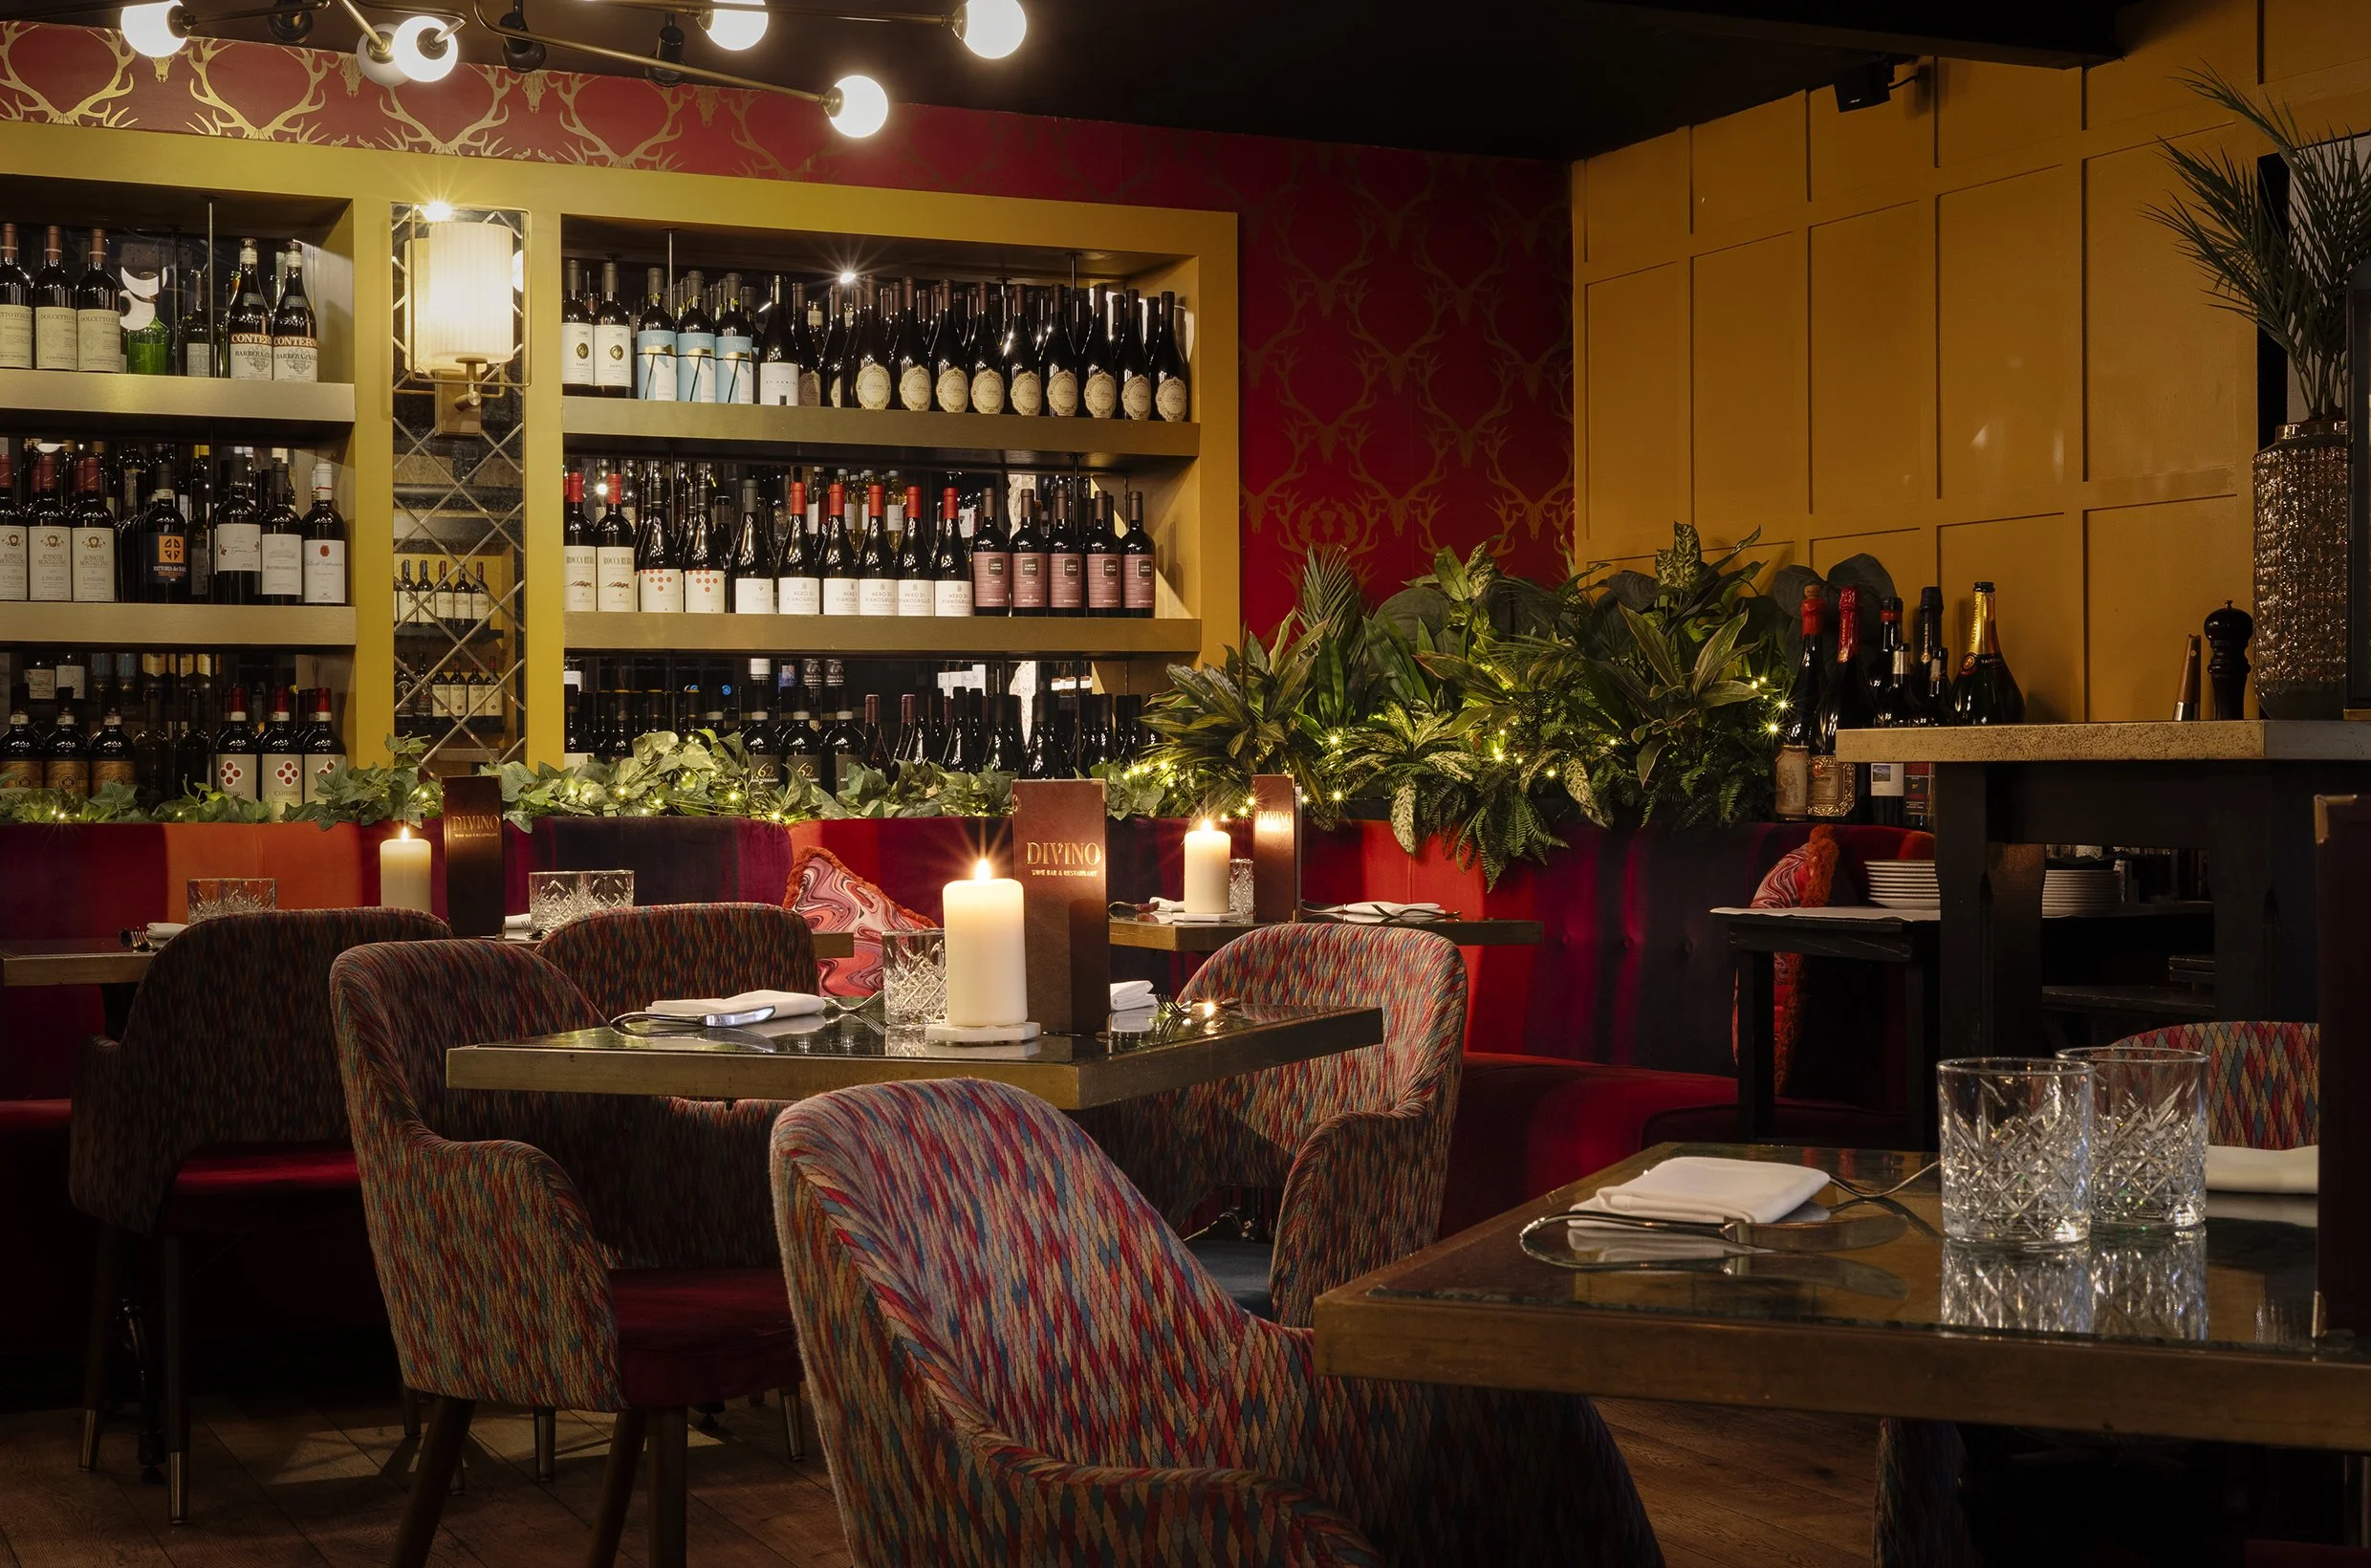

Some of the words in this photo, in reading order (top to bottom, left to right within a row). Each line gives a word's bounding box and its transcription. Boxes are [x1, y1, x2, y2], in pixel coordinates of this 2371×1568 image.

[231, 333, 272, 345] CONTER
[758, 762, 774, 777] 62
[451, 815, 500, 831] DIVINO
[1258, 811, 1293, 825] DIVINO
[1026, 841, 1101, 865] DIVINO
